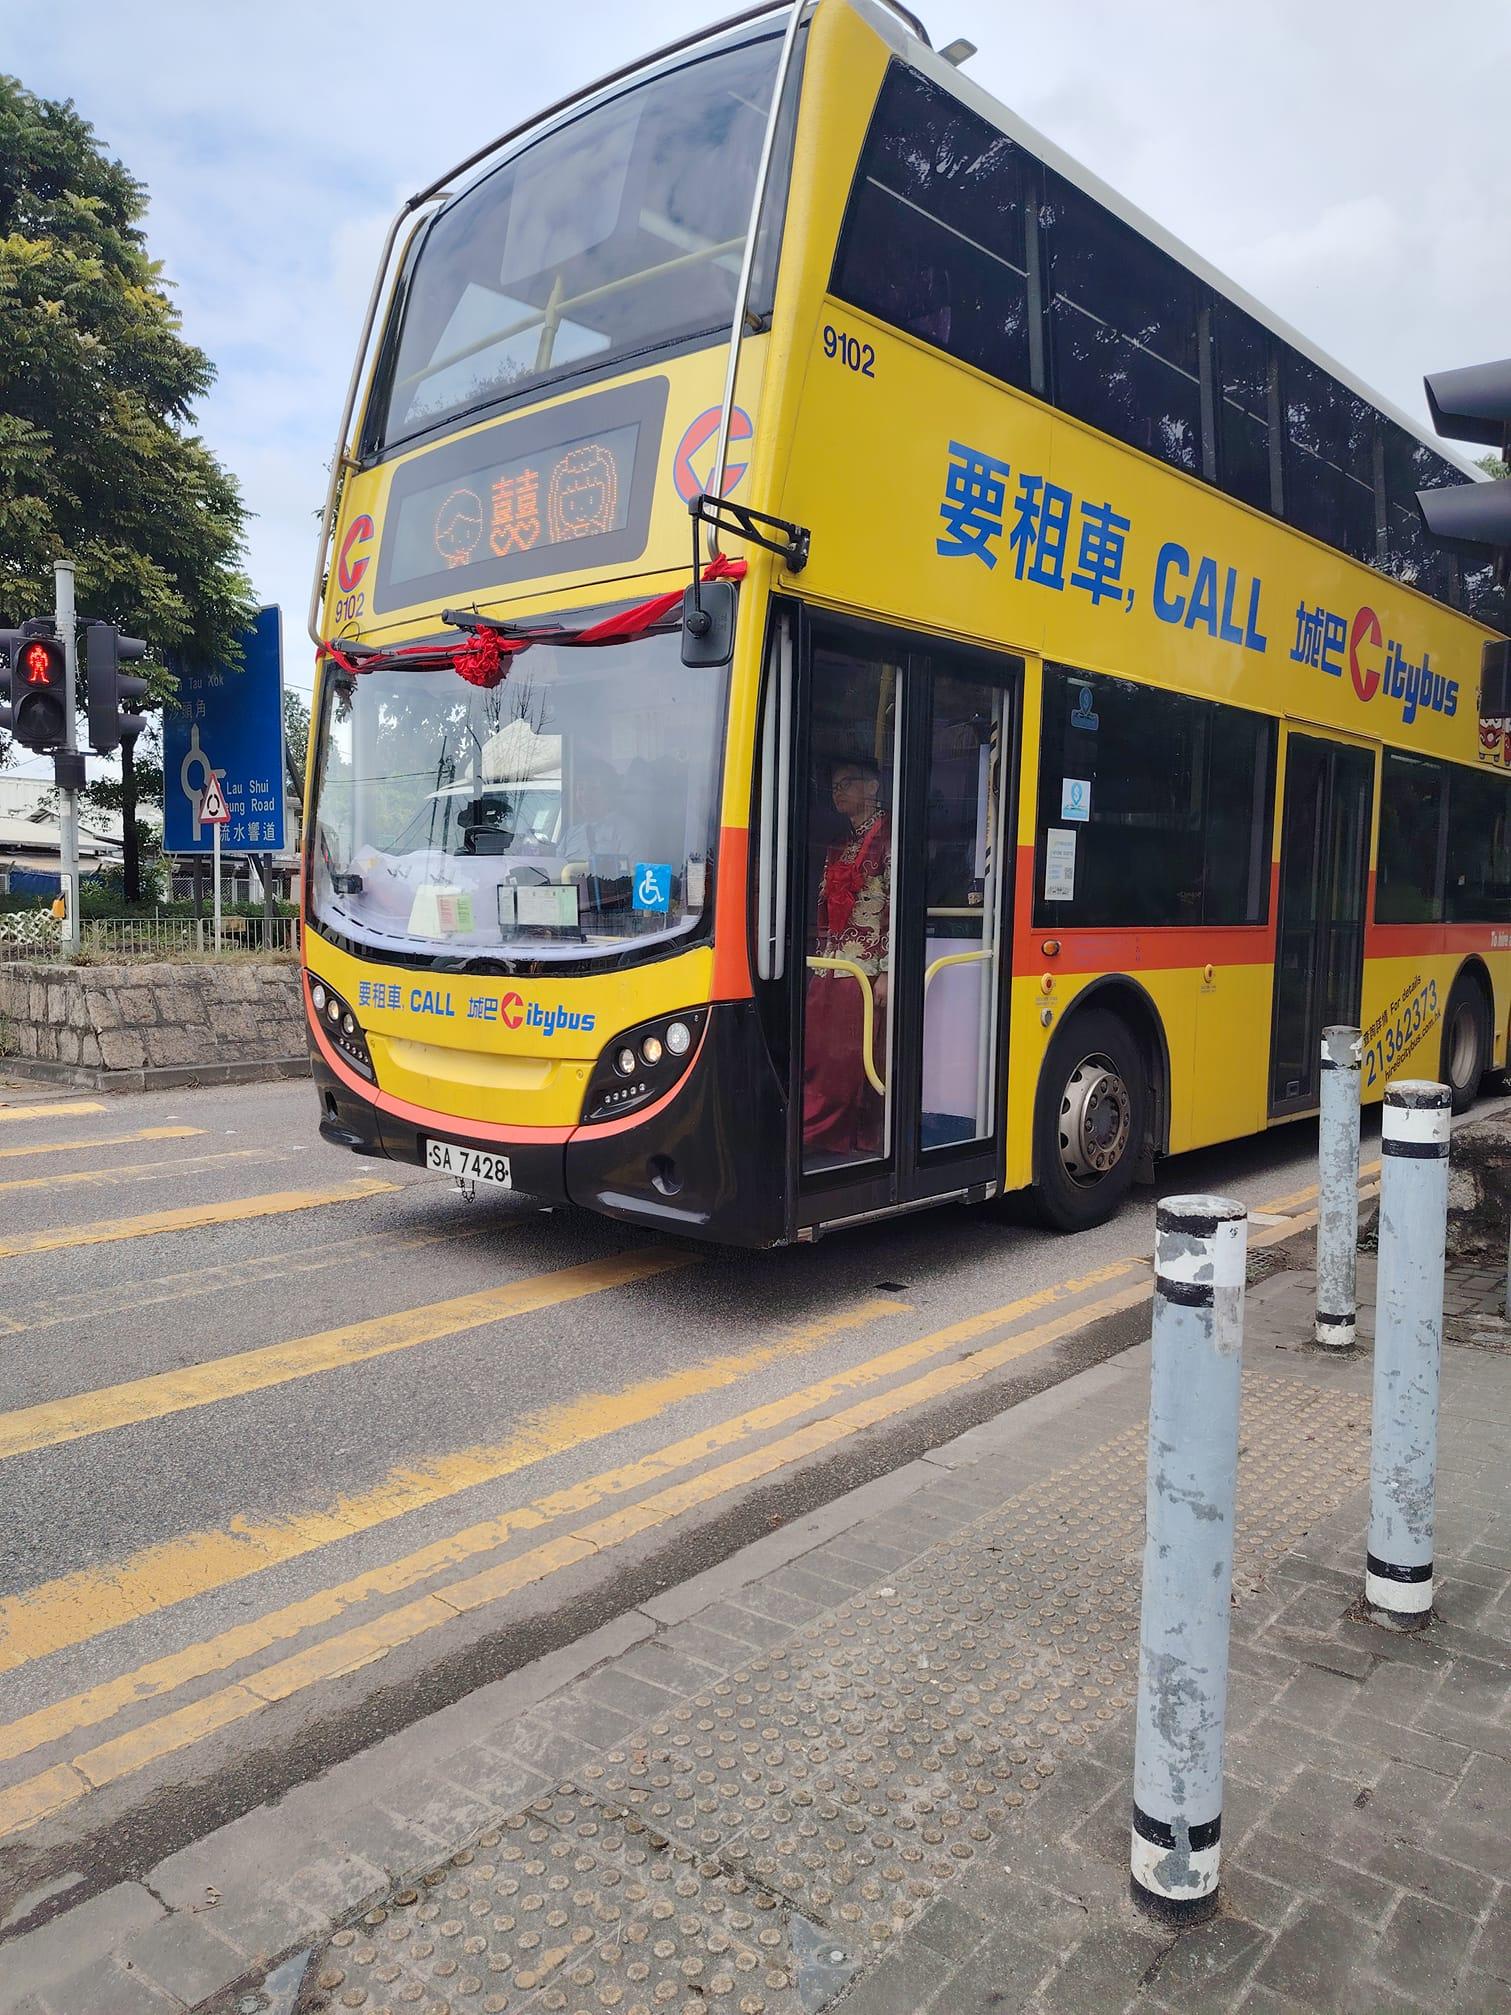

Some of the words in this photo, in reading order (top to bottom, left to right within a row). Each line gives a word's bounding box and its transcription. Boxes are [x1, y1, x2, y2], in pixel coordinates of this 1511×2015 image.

[823, 325, 875, 378] 9102
[936, 439, 1135, 613] 要租車,
[1152, 542, 1267, 653] CALL
[1290, 600, 1347, 677] 城巴
[1350, 606, 1459, 724] Citybus
[336, 592, 365, 623] 9102
[189, 677, 202, 689] Tau
[226, 781, 243, 795] Lau
[249, 779, 269, 793] Shui
[225, 801, 245, 816] eung
[251, 797, 275, 812] Road
[220, 821, 276, 842] 流水響道
[410, 989, 455, 1017] CALL
[467, 996, 498, 1021] 城巴
[501, 991, 596, 1037] Citybus
[1390, 999, 1401, 1015] For
[1402, 975, 1421, 1002] details
[1366, 979, 1437, 1087] 21362373
[433, 1145, 452, 1171] SA
[460, 1151, 506, 1182] 7428
